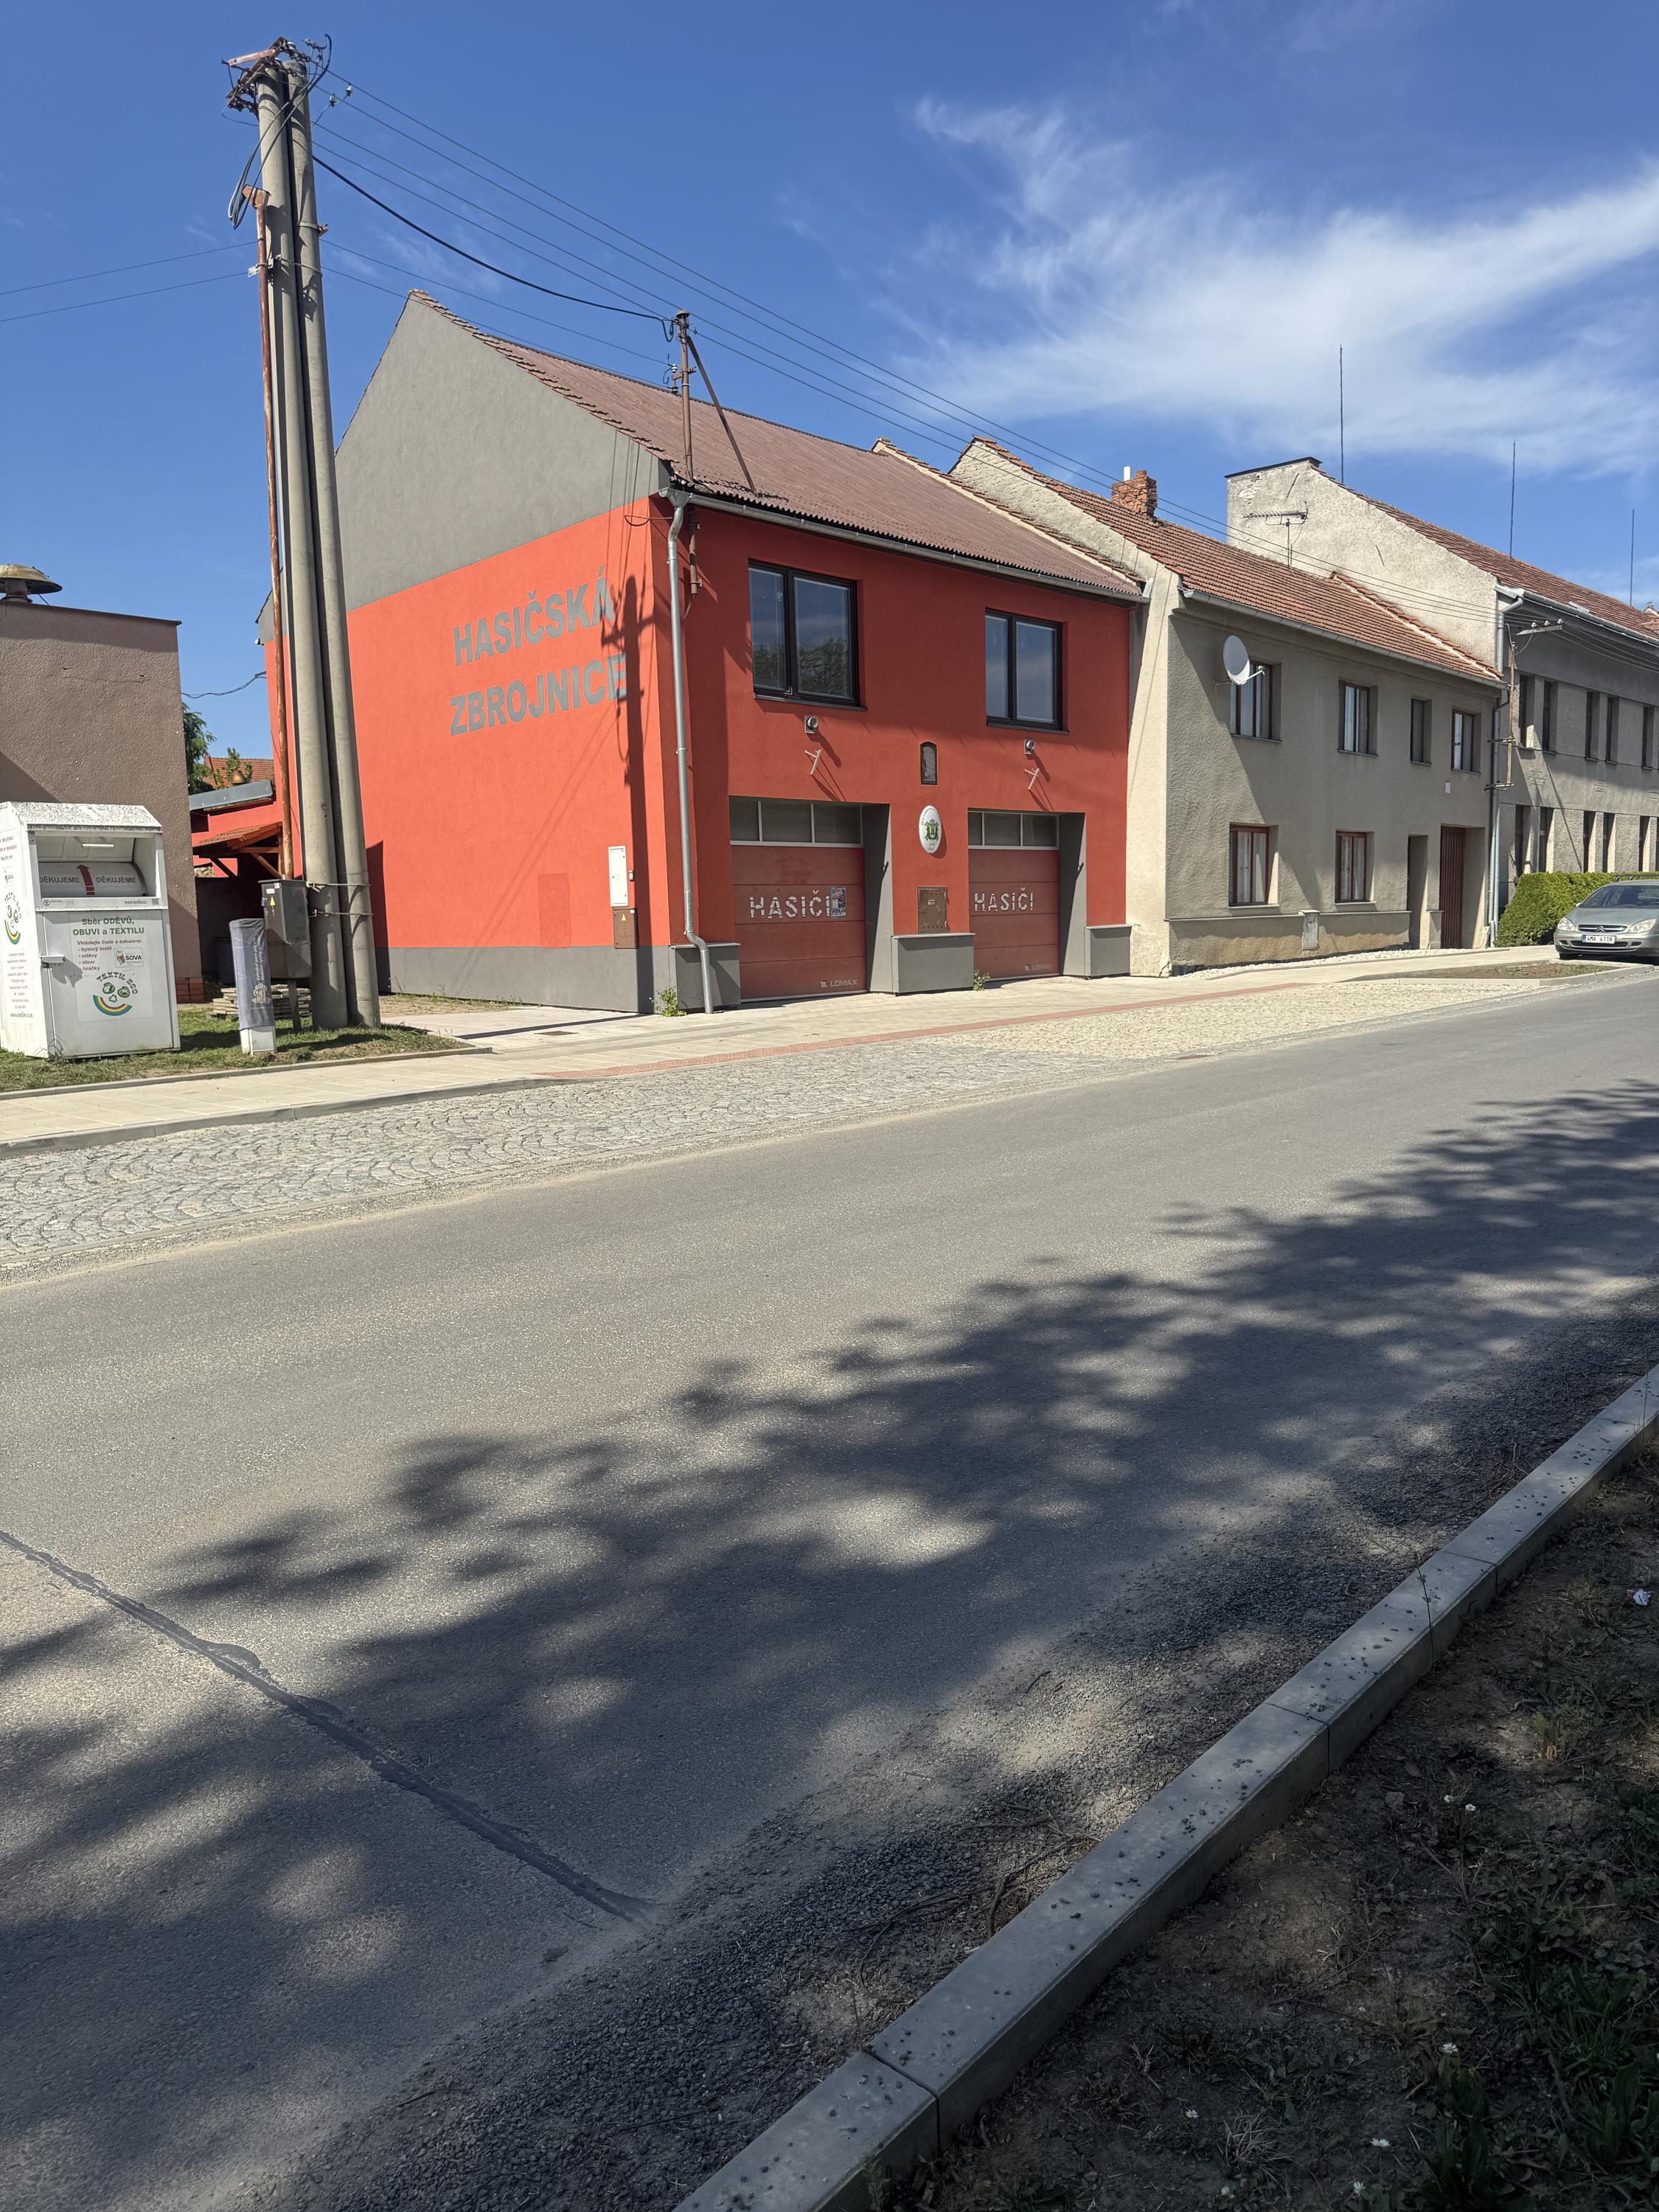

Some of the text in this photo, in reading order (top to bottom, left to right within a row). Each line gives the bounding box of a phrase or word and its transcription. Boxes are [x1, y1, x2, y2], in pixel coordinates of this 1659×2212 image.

[453, 566, 615, 667] HASIČSKÁ
[450, 653, 627, 736] ZBROJNICE
[749, 889, 830, 919] HASIČI
[109, 927, 145, 935] TEXTILU
[96, 971, 125, 981] TEXTIL
[830, 979, 858, 987] LOMAX
